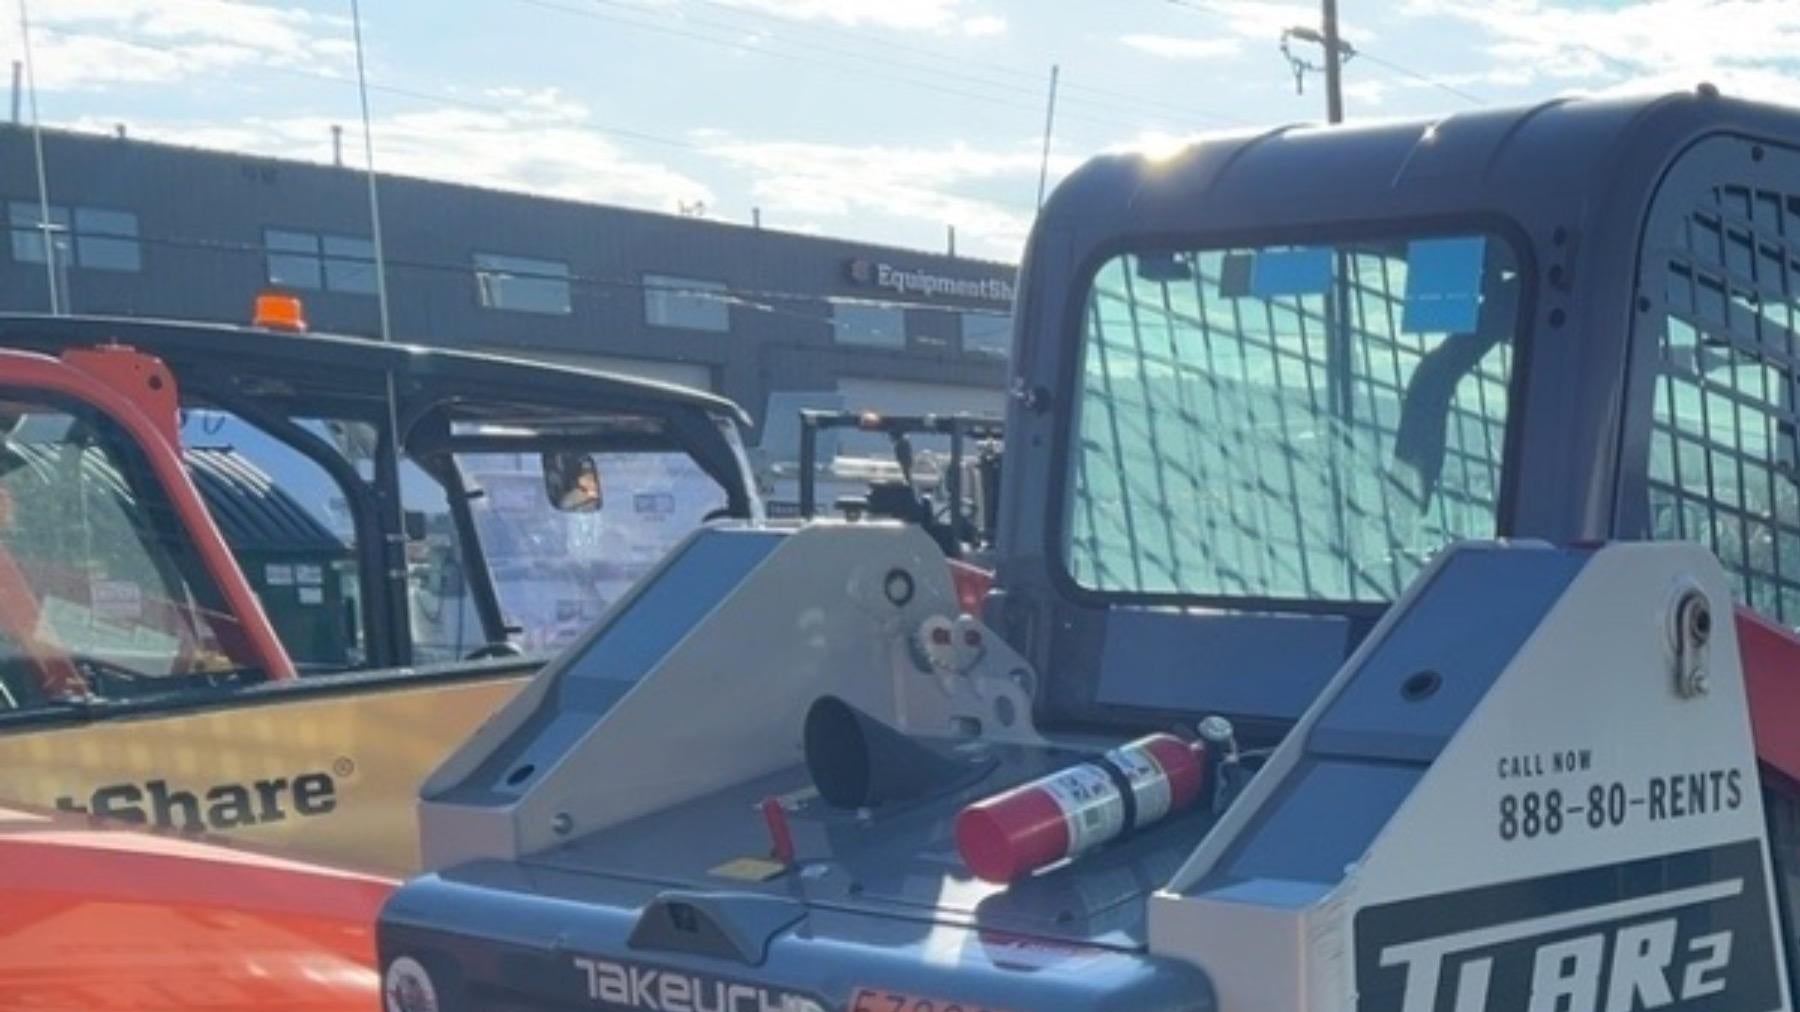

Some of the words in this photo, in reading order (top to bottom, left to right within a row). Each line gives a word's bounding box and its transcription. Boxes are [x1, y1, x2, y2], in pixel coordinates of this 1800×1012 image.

[1498, 753, 1544, 779] CALL
[1552, 749, 1592, 772] NOW
[1500, 768, 1742, 840] 888-80-RENTS
